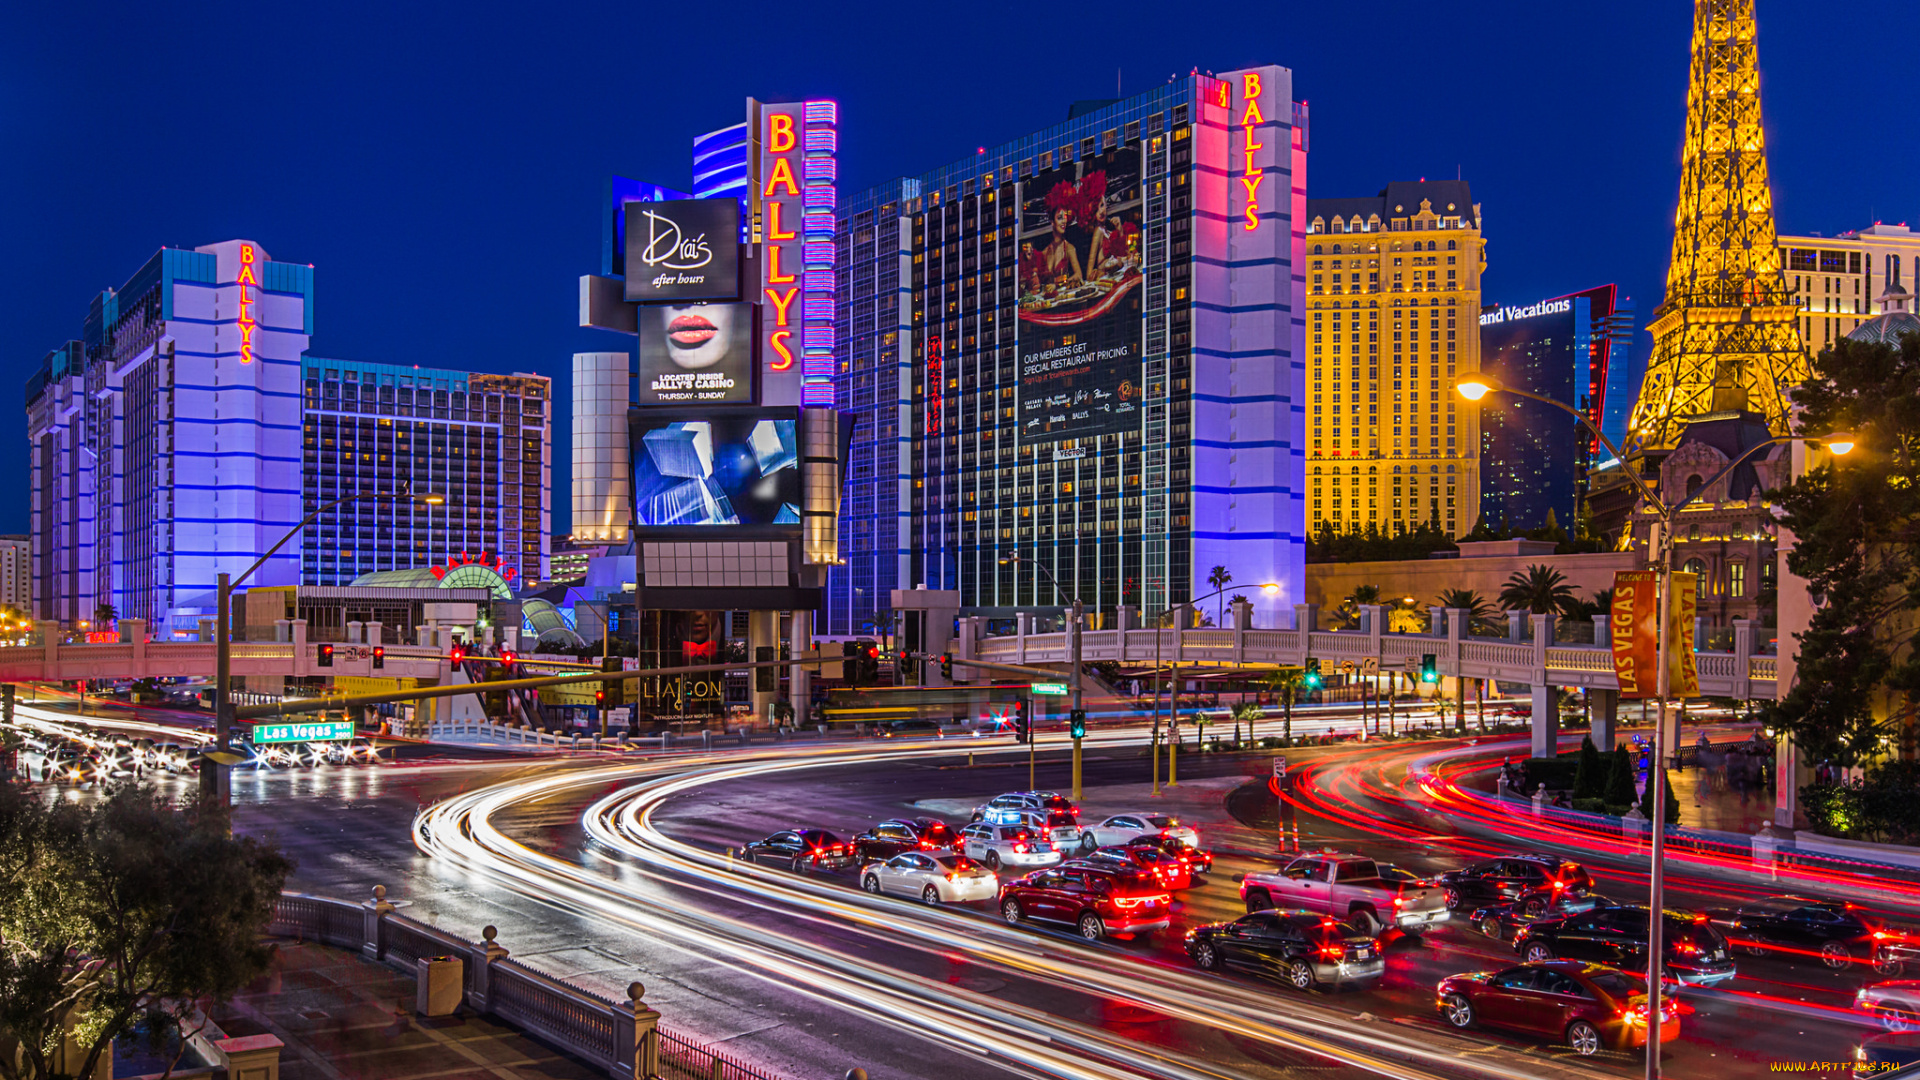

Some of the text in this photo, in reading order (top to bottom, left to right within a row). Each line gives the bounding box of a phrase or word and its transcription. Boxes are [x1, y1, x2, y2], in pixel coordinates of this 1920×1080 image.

[1241, 73, 1264, 231] BALLYS
[642, 209, 713, 269] Drai's
[765, 113, 800, 370] BALLYS
[652, 272, 704, 288] after hours
[237, 244, 258, 364] BALLYS
[1479, 299, 1570, 325] and Vacations
[1024, 342, 1087, 364] OUR MEMBERS GET
[1024, 361, 1050, 376] SPECIAL
[1051, 351, 1096, 370] RESTAURANT
[651, 379, 735, 390] BALLY'S CASINO
[659, 372, 724, 382] LOCATED INSIDE
[658, 392, 694, 400] THURSDAY
[698, 391, 726, 399] SUNDAY
[1059, 448, 1085, 458] VECTOR
[430, 551, 518, 581] BALLYS
[1682, 588, 1695, 624] LAS
[1614, 586, 1638, 693] LAS VEGAS
[263, 726, 288, 739] Las
[292, 724, 331, 740] Vegas
